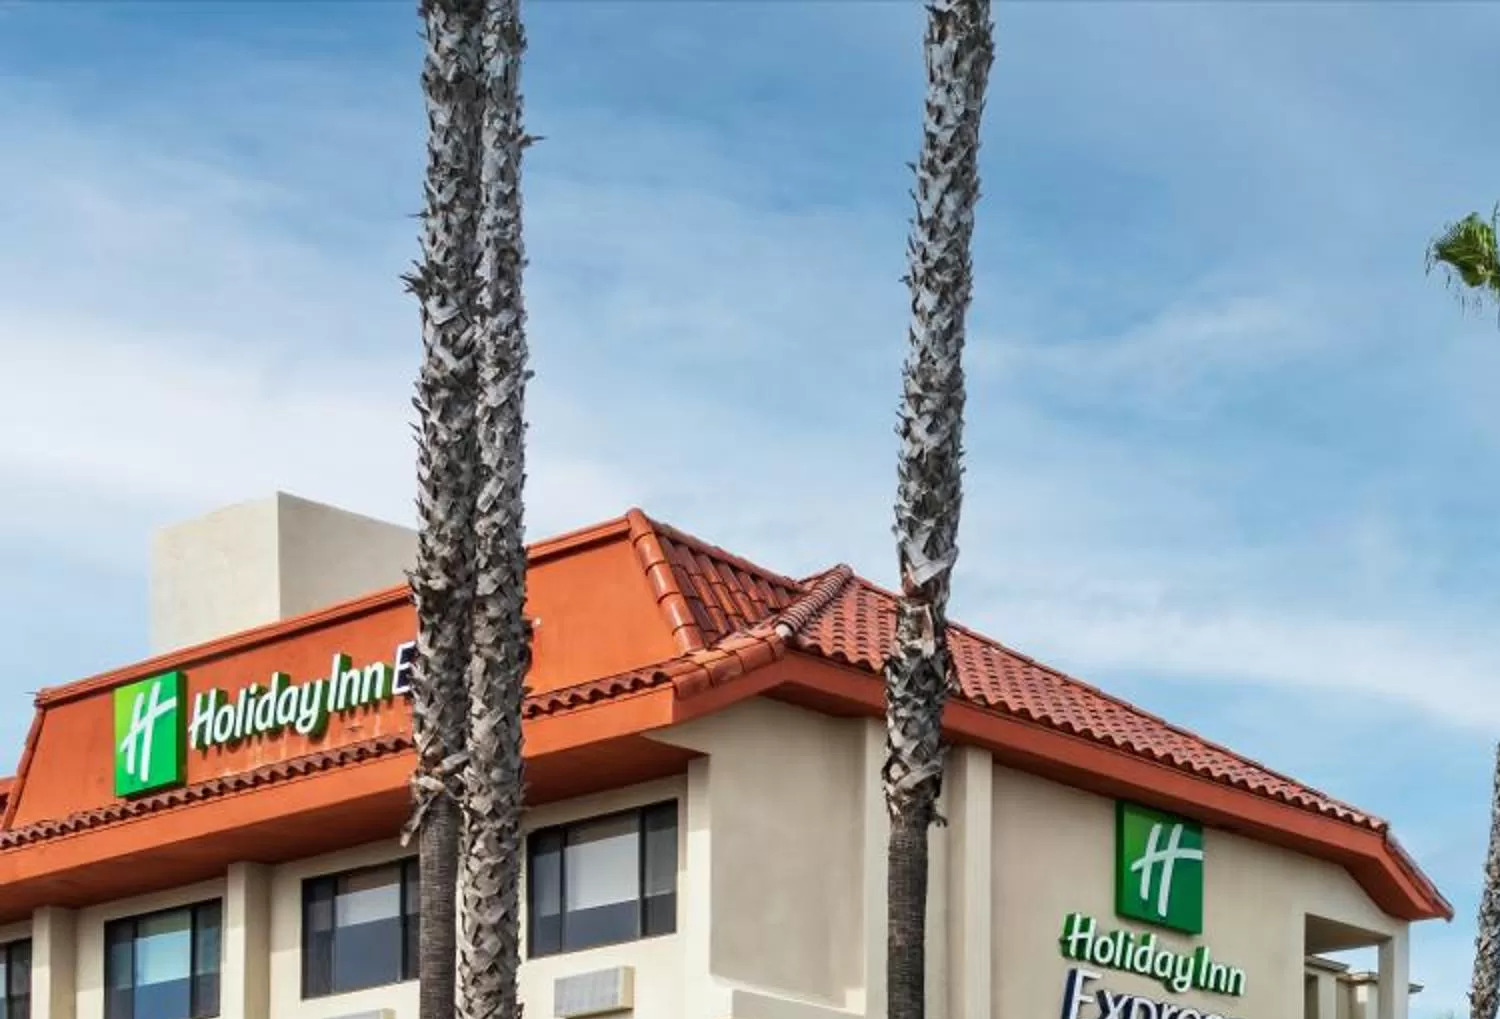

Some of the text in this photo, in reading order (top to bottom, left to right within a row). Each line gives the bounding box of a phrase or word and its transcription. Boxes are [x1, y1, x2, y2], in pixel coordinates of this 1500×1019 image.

[187, 671, 322, 750] Holiday
[327, 653, 385, 714] Inn
[1065, 912, 1247, 996] Holiday Inn
